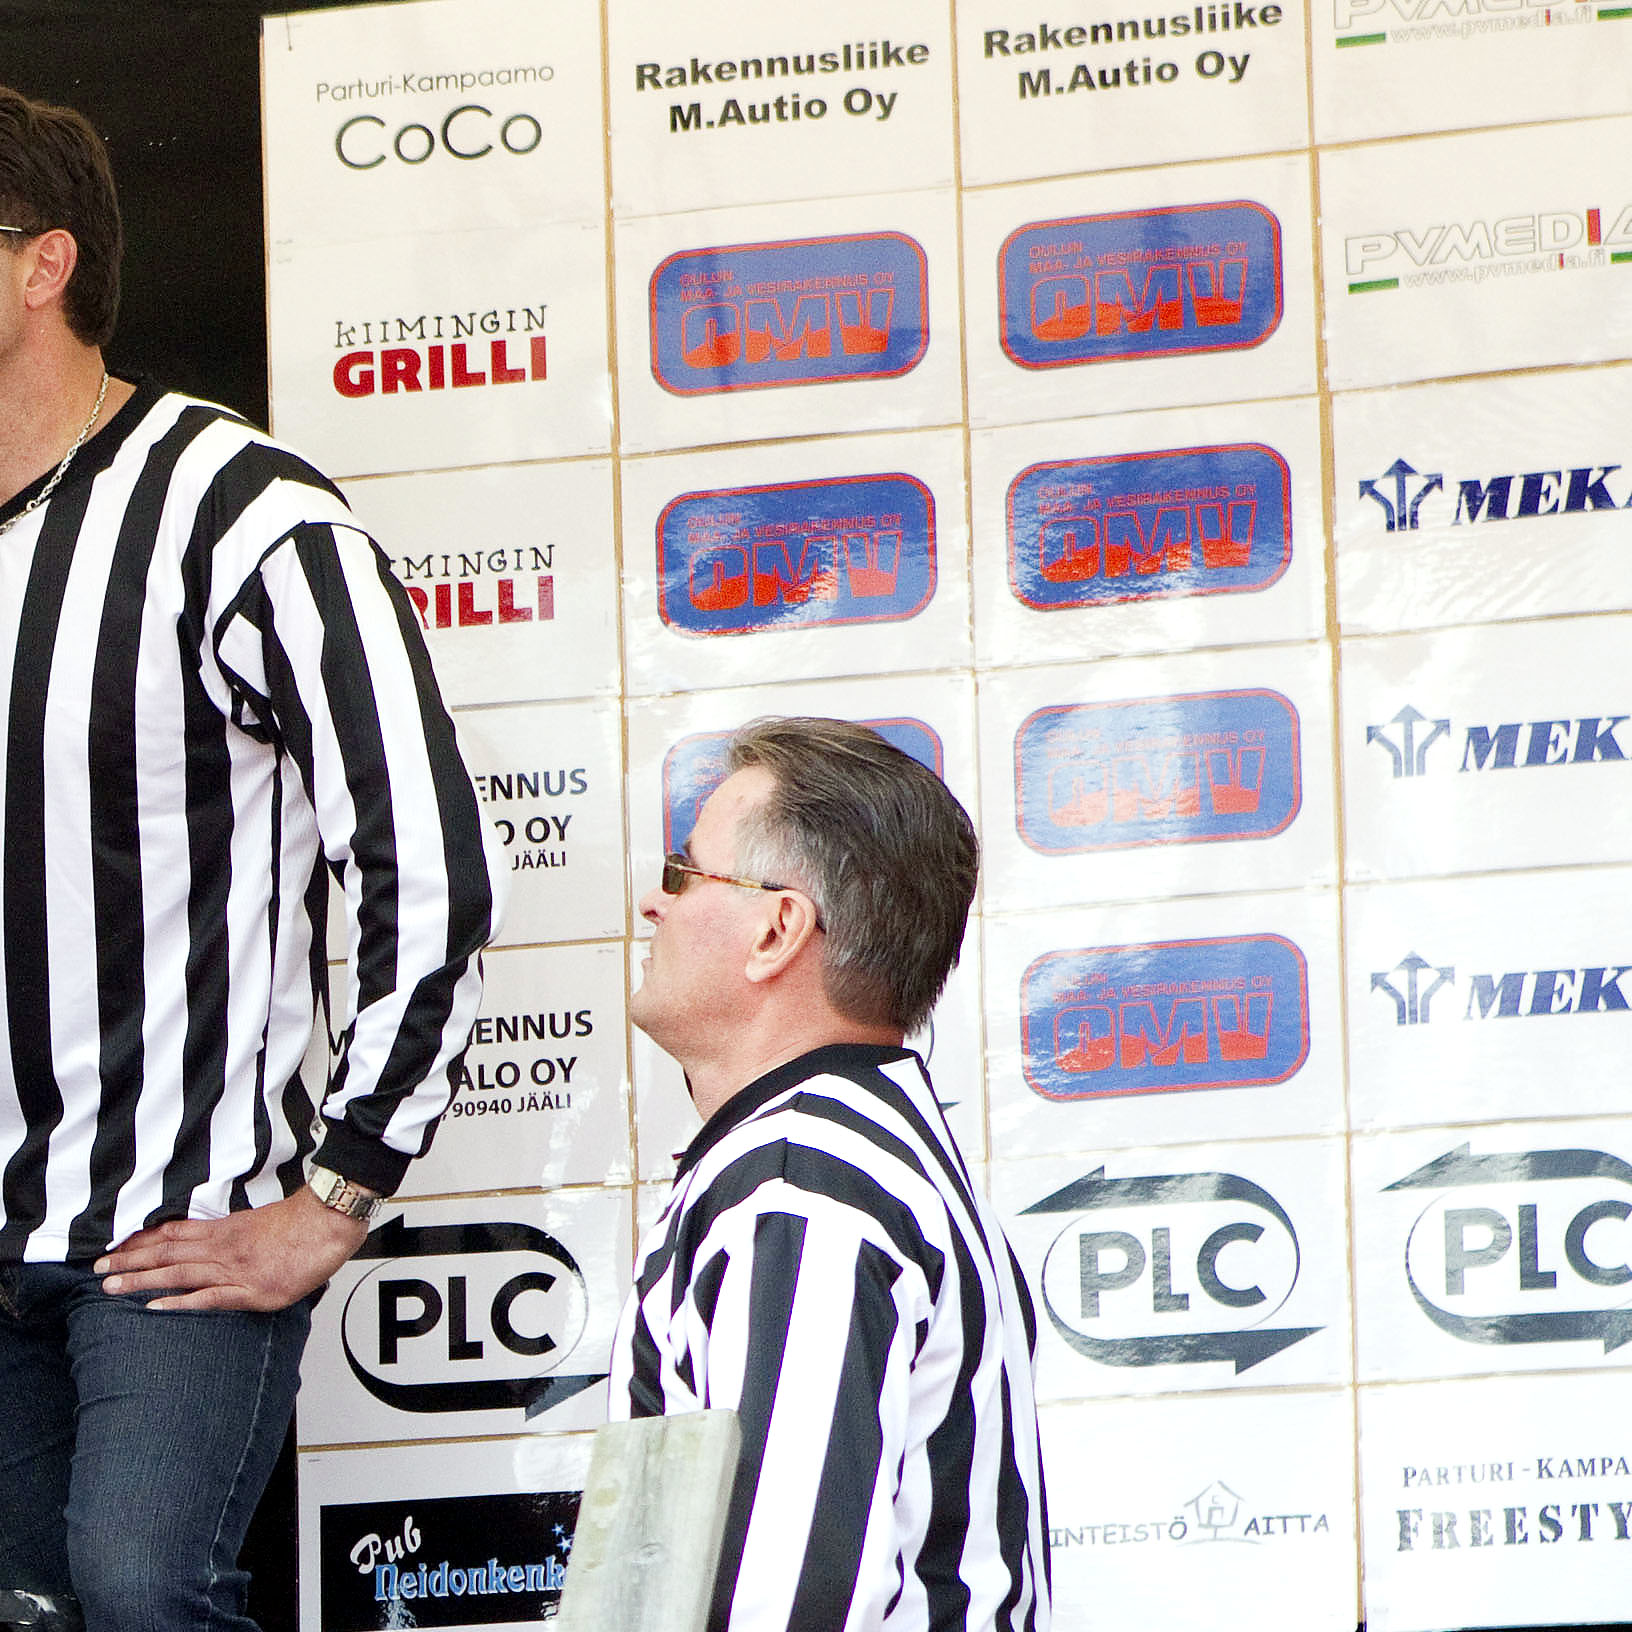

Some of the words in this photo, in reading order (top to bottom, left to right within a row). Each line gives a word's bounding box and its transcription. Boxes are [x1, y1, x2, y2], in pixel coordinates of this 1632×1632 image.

[983, 2, 1284, 59] Rakennusliike
[316, 66, 554, 102] Parturi-Kampaamo
[635, 42, 929, 92] Rakennusliike
[1018, 56, 1179, 99] M.Autio
[1195, 50, 1251, 85] Oy
[669, 93, 828, 133] M.Autio
[844, 87, 898, 121] Oy
[335, 104, 542, 170] CoCo
[1225, 242, 1249, 256] OY
[335, 305, 547, 348] KIIMINGIN
[333, 336, 547, 398] GRILLI
[525, 815, 573, 843] OY
[512, 849, 566, 871] JÄÄLI
[468, 1010, 593, 1046] ENNUS
[530, 1056, 577, 1086] OY
[453, 1098, 512, 1118] 90940
[517, 1091, 571, 1113] JÄÄLI
[1080, 1222, 1267, 1319] PLC
[1444, 1200, 1632, 1295] PLC
[378, 1271, 557, 1365] PLC
[350, 1515, 422, 1574] Pub
[1244, 1513, 1330, 1538] AITTA
